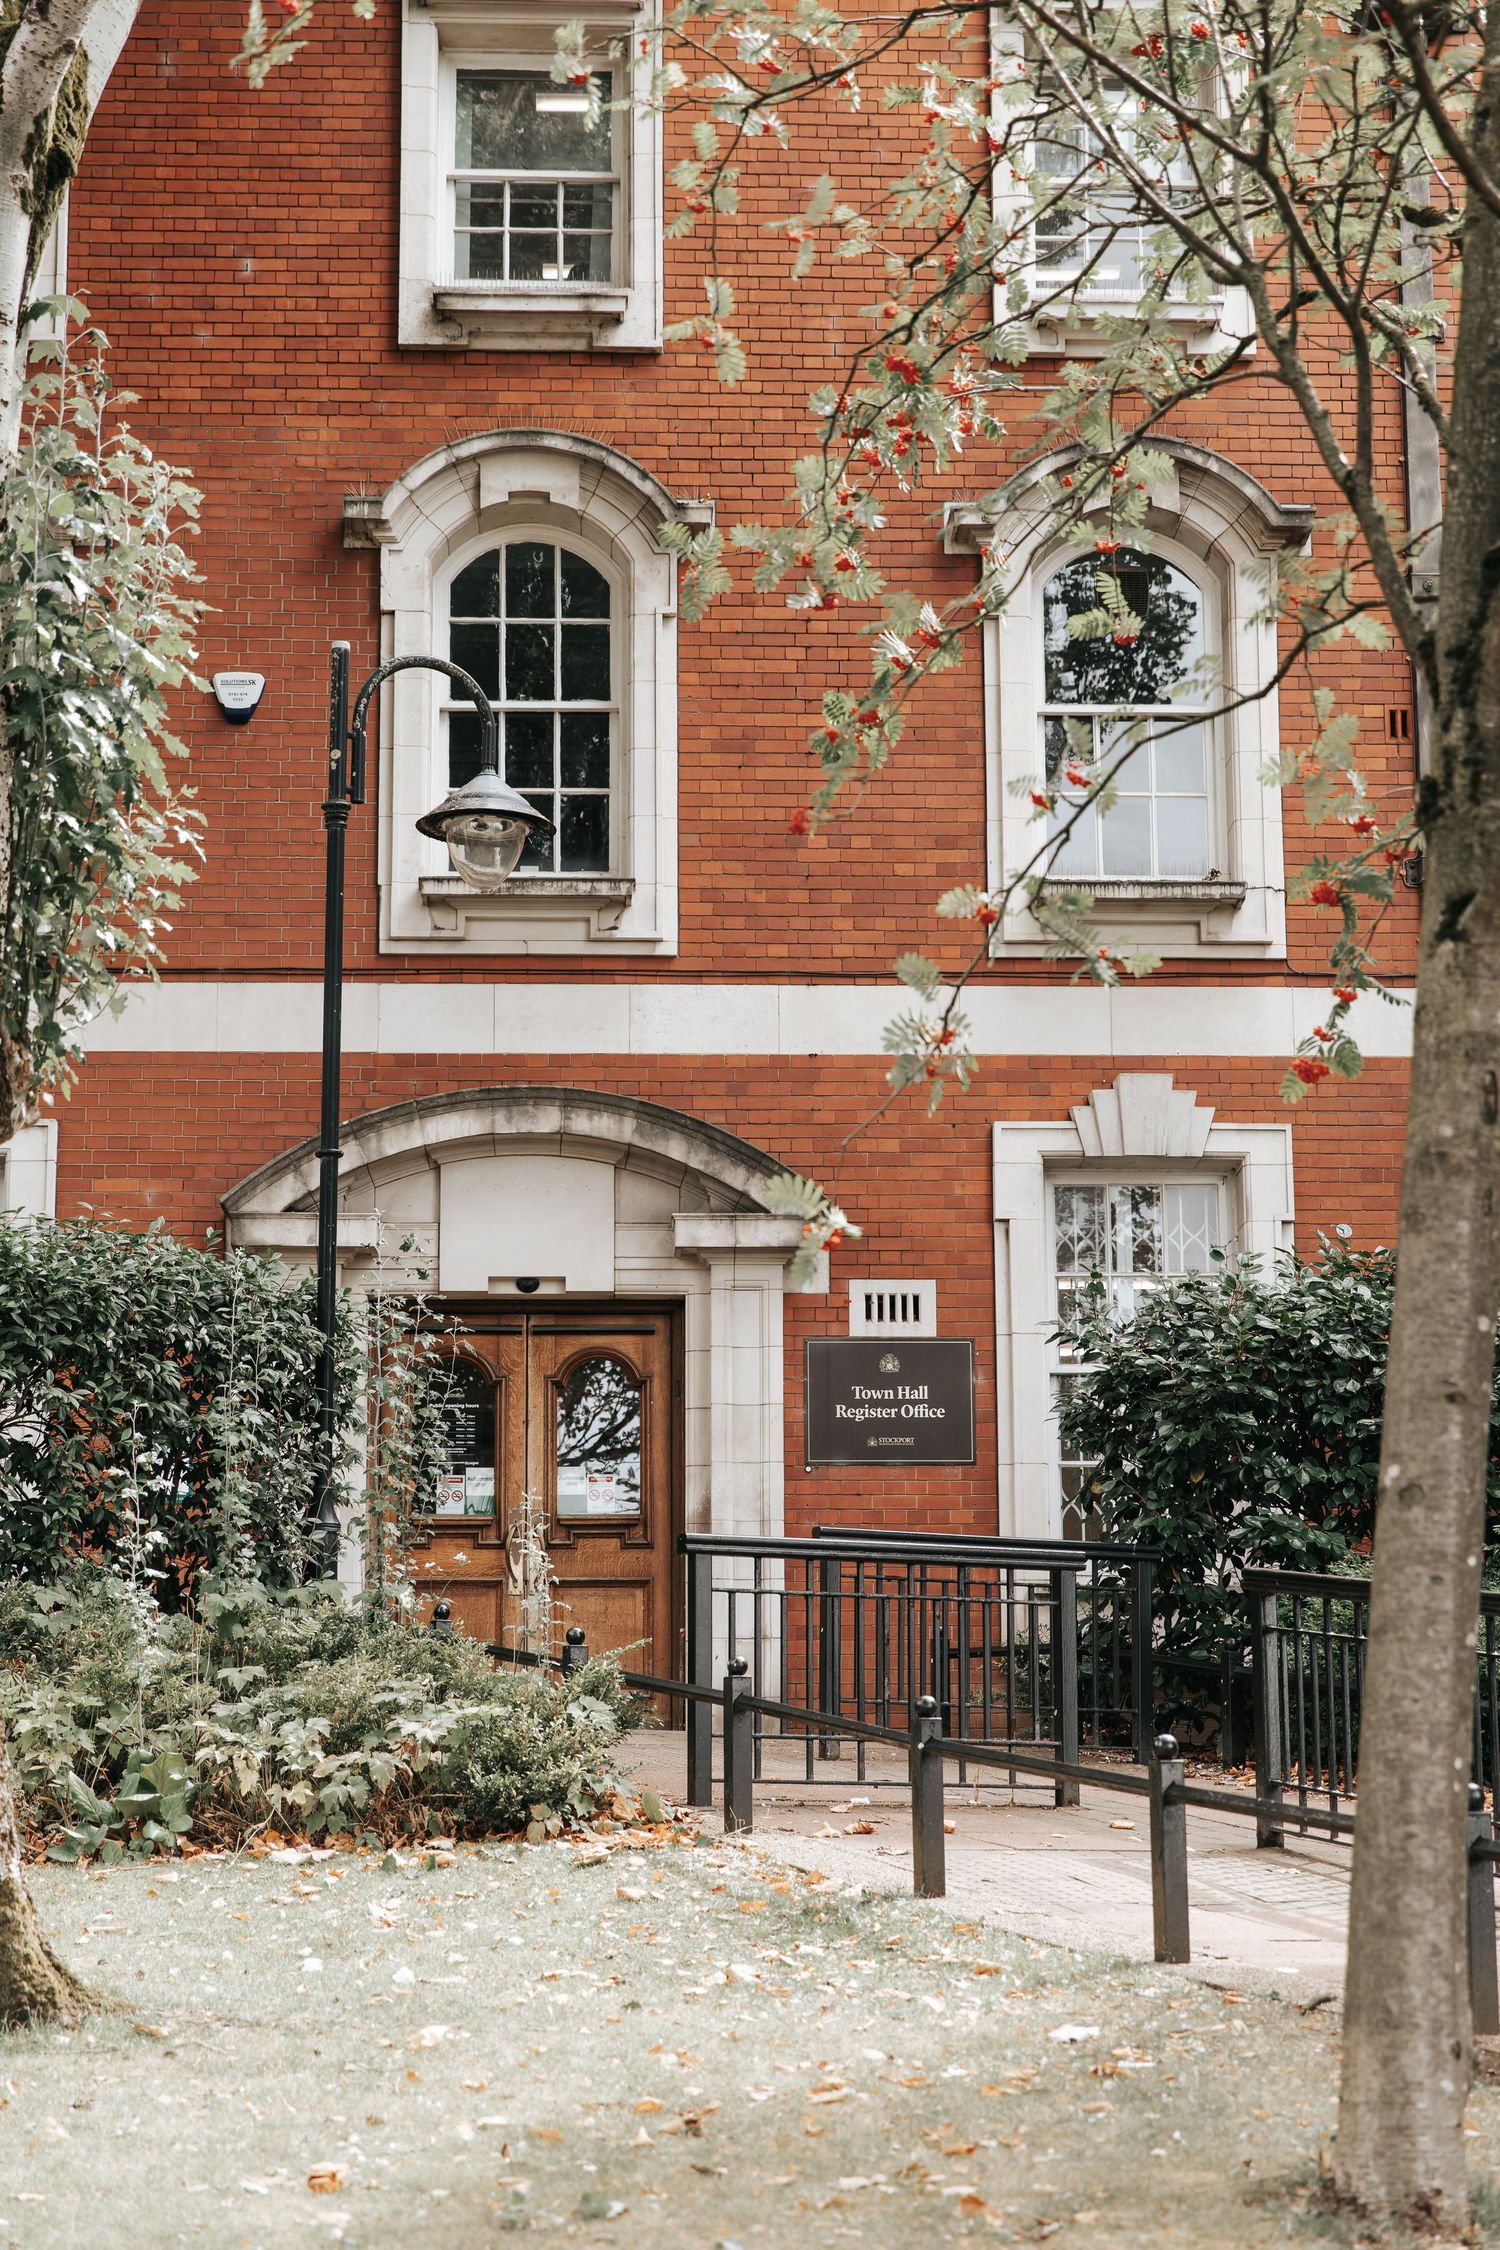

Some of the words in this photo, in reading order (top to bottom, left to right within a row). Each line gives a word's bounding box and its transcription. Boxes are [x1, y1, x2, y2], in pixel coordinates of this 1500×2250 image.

[851, 1385, 895, 1400] Town
[897, 1385, 929, 1400] Hall
[835, 1404, 898, 1422] Register
[900, 1403, 946, 1418] Office
